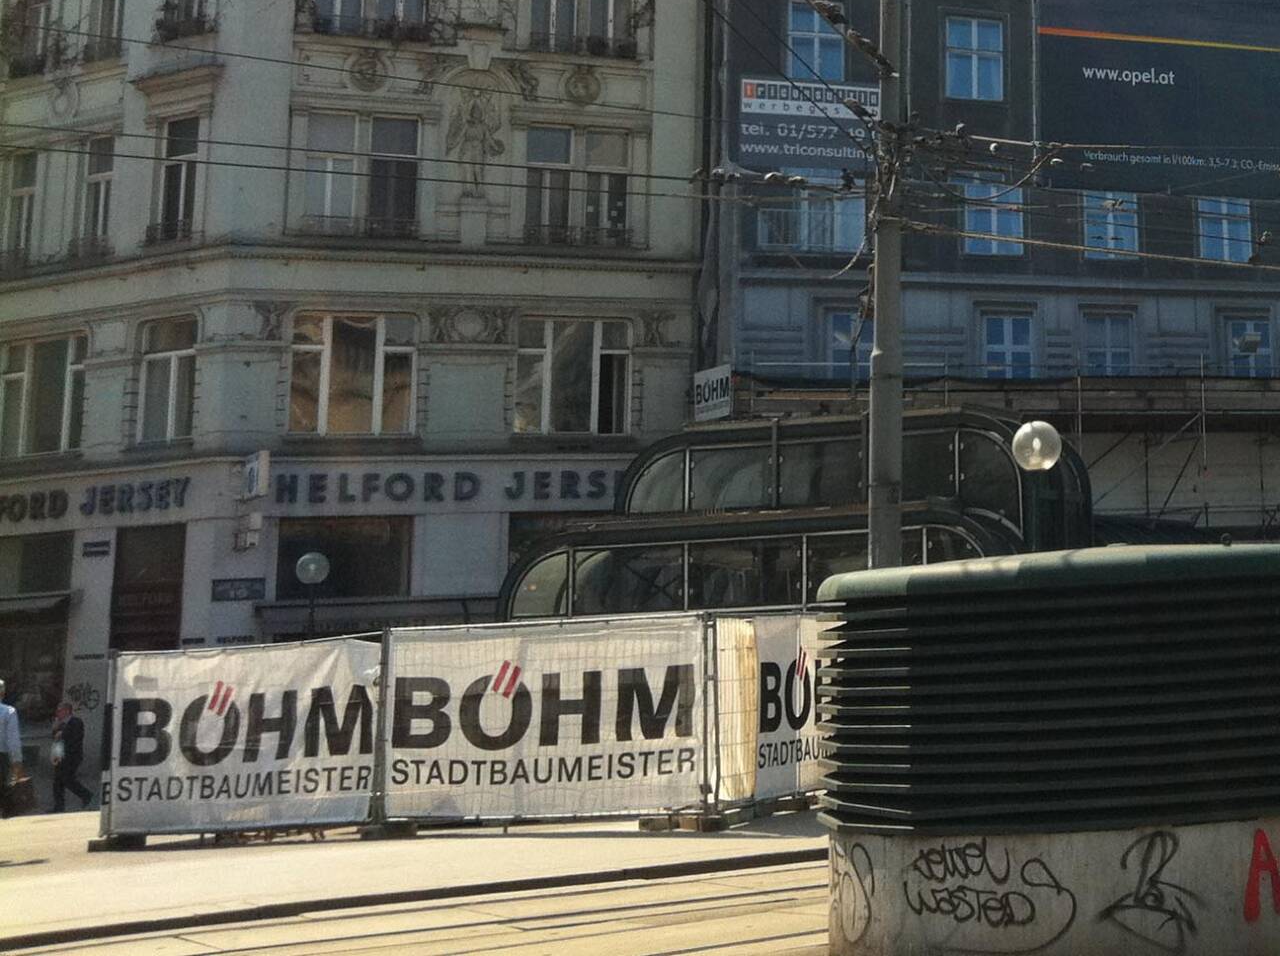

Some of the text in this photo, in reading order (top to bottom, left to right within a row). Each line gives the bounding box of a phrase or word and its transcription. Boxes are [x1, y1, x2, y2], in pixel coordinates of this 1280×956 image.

[1082, 67, 1175, 86] www.opel.at
[741, 124, 770, 136] tel.
[777, 123, 839, 139] 01/577
[1083, 149, 1128, 162] Verbrauch
[1129, 154, 1161, 165] gesamt
[695, 376, 730, 405] BÖHM
[80, 476, 192, 517] JERSEY
[275, 470, 622, 504] HELFORD JERS
[391, 659, 696, 751] BÖHM
[119, 680, 374, 767] BÖHM
[117, 766, 372, 802] STADTBAUMEISTER
[391, 747, 696, 786] STADTBAUMEISTER
